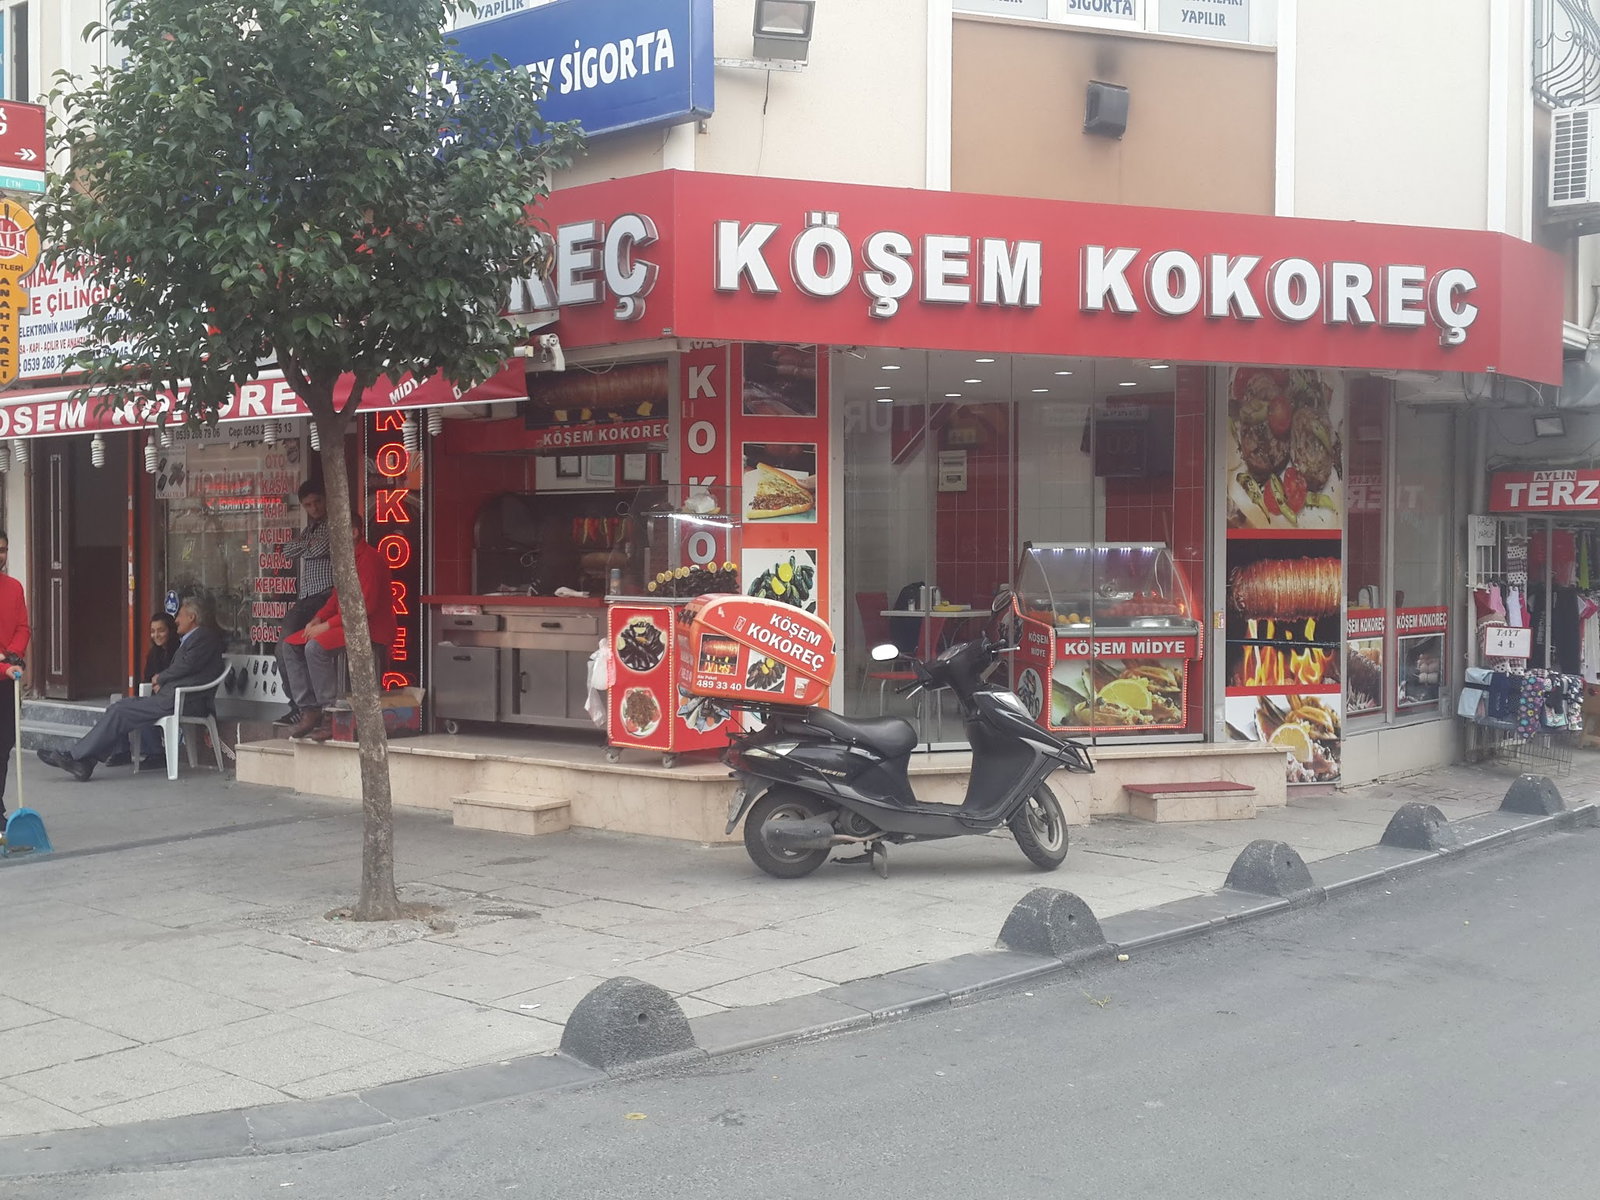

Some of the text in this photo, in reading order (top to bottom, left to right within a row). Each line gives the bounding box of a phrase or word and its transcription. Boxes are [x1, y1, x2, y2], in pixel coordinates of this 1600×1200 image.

[1181, 9, 1227, 27] YAPILIR
[559, 28, 675, 95] SİGORTA
[713, 211, 1480, 346] KÖŞEM KOKOREÇ
[23, 357, 40, 372] 0539
[42, 355, 55, 369] 268
[544, 430, 593, 447] KÖŞEM
[1505, 480, 1600, 507] TERZ
[255, 577, 297, 593] KEPENK
[769, 613, 822, 647] KÖŞEM
[1397, 612, 1448, 632] KÖŞEM KOKOREÇ
[1496, 629, 1520, 637] TAYT
[746, 622, 826, 672] KOKOREÇ
[1064, 638, 1186, 657] KÖŞEM MİDYE
[696, 680, 742, 691] 489 33 40
